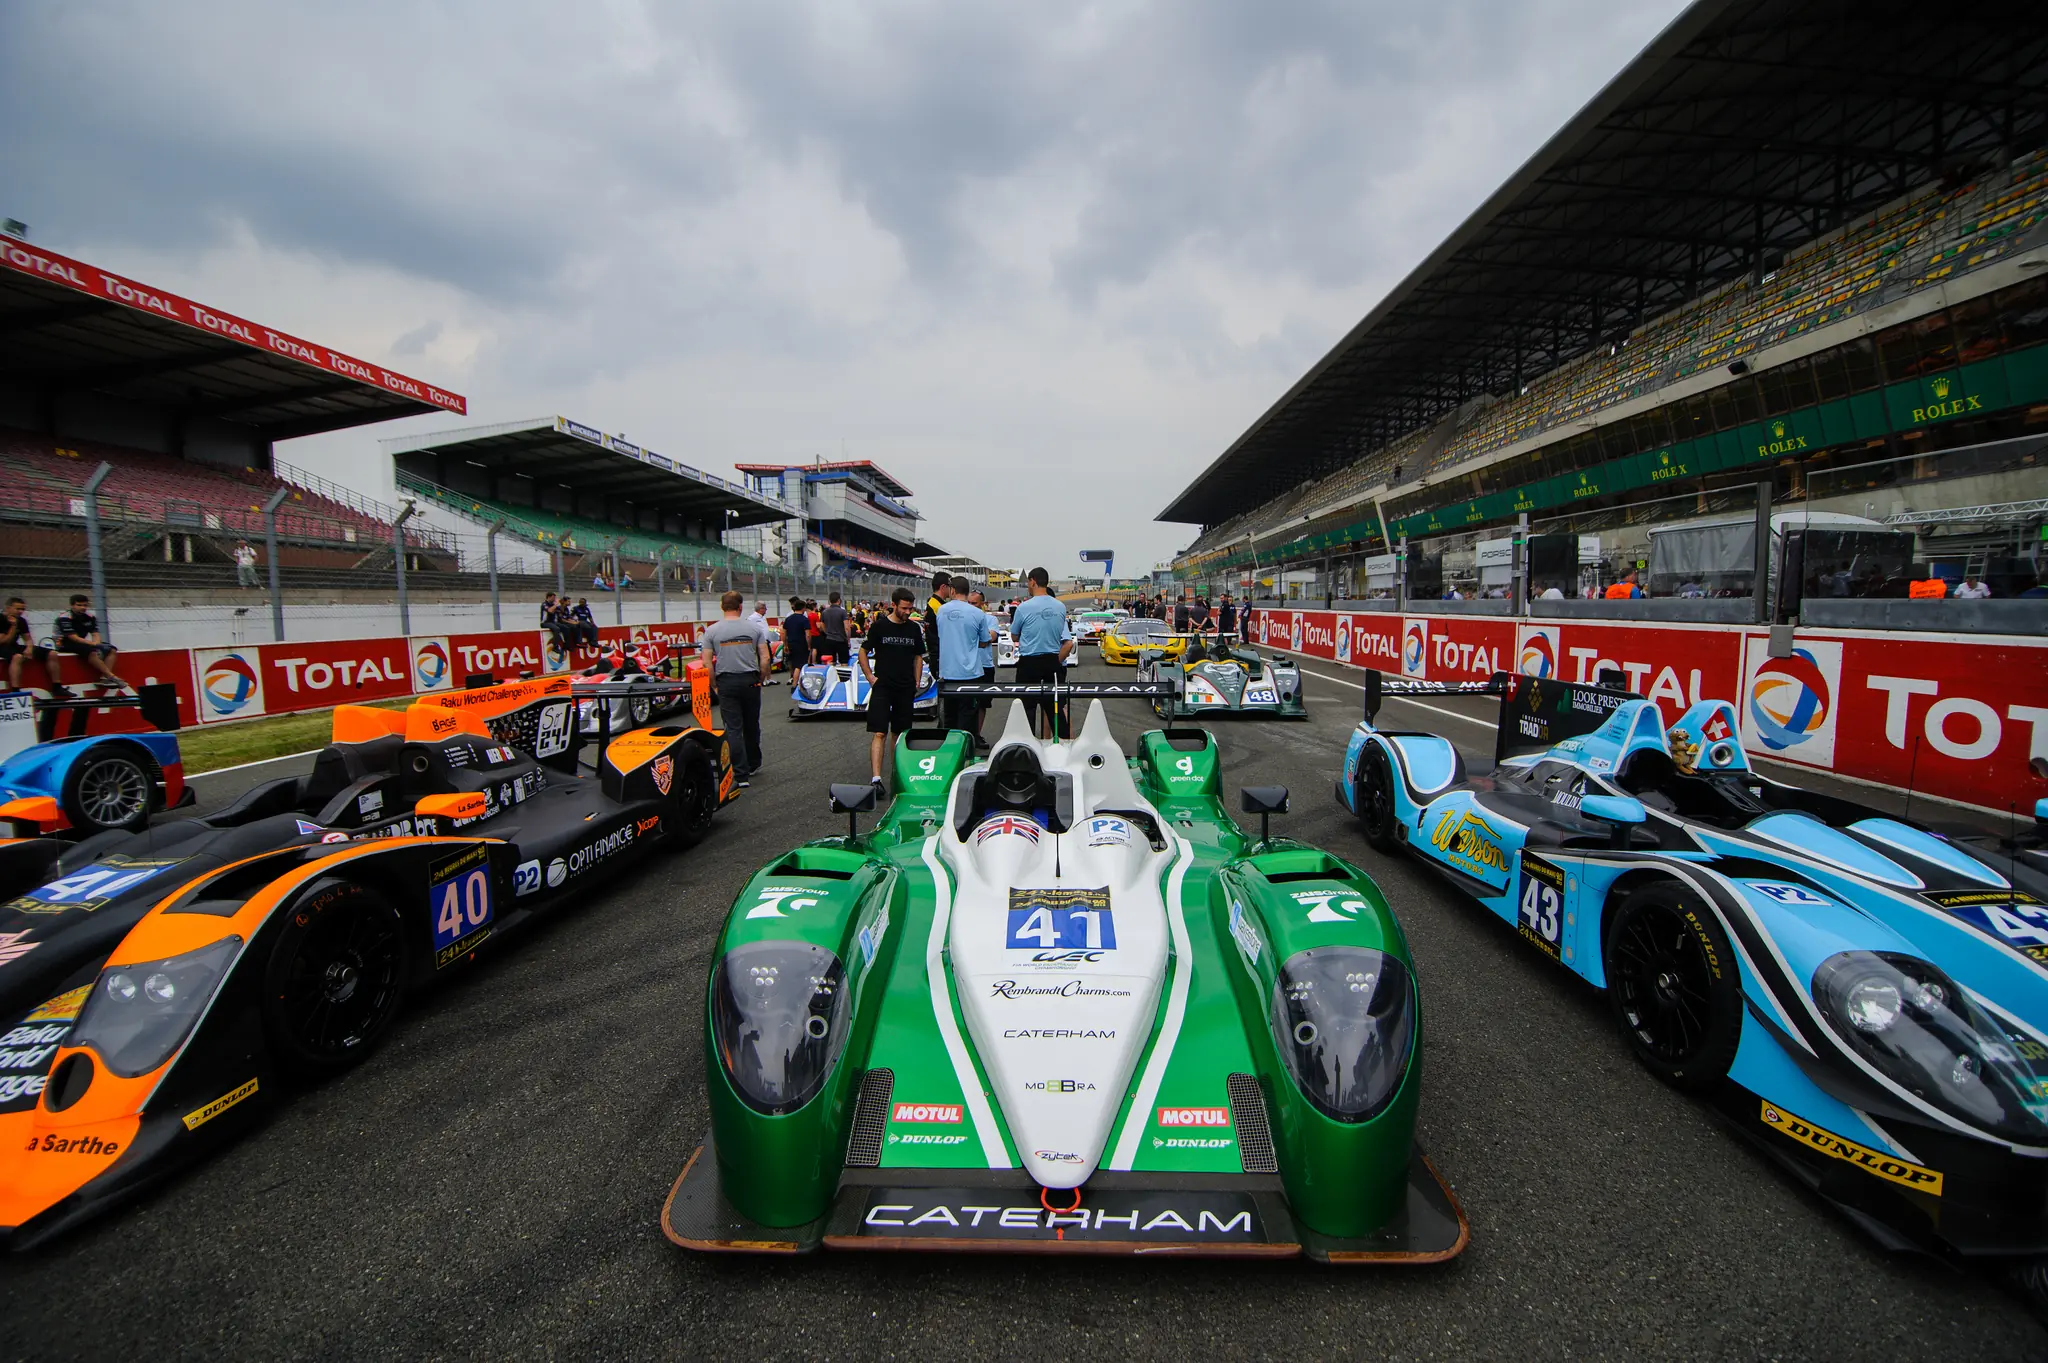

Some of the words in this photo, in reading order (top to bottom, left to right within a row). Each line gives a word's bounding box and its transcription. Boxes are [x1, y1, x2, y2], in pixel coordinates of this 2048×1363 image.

[0, 240, 87, 288] TOTAL
[99, 273, 180, 317] TOTAL
[190, 304, 256, 342] TOTAL
[264, 330, 320, 364] TOTAL
[326, 352, 375, 381] TOTAL
[380, 371, 423, 397] TOTAL
[426, 387, 464, 411] TOTAL
[1911, 394, 1983, 423] ROLEX
[1758, 436, 1808, 457] ROLEX
[1651, 464, 1688, 481] ROLEX
[1573, 484, 1600, 499] ROLEX
[1513, 500, 1535, 512] ROLEX
[1466, 512, 1484, 523] ROLEX
[1367, 561, 1392, 571] PORSCHE
[1268, 618, 1291, 640] TOTAL
[1304, 622, 1334, 647] TOTAL
[1354, 626, 1400, 659] TOTAL
[457, 645, 539, 673] TOTAL
[1432, 634, 1508, 676] TOTAL
[274, 656, 405, 693] TOTAL
[440, 694, 463, 708] Baku
[463, 692, 487, 705] World
[486, 687, 522, 702] Challenge
[1250, 690, 1274, 702] 48
[1573, 689, 1597, 705] LOOK
[1572, 701, 1604, 715] IMMOBILIER
[1519, 719, 1549, 741] TRADOR
[1521, 714, 1548, 726] INVESTOR
[909, 775, 930, 783] green
[930, 773, 943, 781] dot
[1169, 775, 1190, 783] green
[1190, 773, 1204, 782] dot
[458, 804, 466, 813] La
[467, 799, 485, 810] Sarthe
[1091, 819, 1126, 834] P2
[1431, 807, 1509, 872] Warson
[569, 846, 593, 872] OPTI
[1448, 853, 1484, 875] MOTORS
[1522, 858, 1530, 868] 24
[42, 868, 158, 901] 40
[514, 866, 539, 891] P2
[760, 886, 830, 897] ZAISGroup
[1013, 889, 1037, 897] 24
[1289, 889, 1361, 899] ZAISGroup
[1761, 885, 1820, 902] P2
[1940, 894, 1958, 905] 24
[436, 870, 488, 938] 40
[1014, 901, 1033, 909] 24
[1032, 896, 1059, 905] HEURES
[1521, 876, 1559, 942] 43
[1015, 907, 1102, 949] 41
[1519, 924, 1530, 939] 24
[439, 945, 454, 965] 24
[1684, 911, 1722, 980] DUNLOP
[1031, 950, 1105, 963] WEC
[990, 979, 1131, 1000] RembrandtCharms.com
[0, 1022, 72, 1046] Baku
[1003, 1029, 1116, 1039] CATERHAM
[0, 1044, 60, 1069] orld
[202, 1081, 257, 1120] DUNLOP
[895, 1105, 960, 1122] MOTUL
[1161, 1109, 1228, 1126] MOTUL
[24, 1136, 39, 1152] a
[41, 1133, 119, 1156] Sarthe
[900, 1134, 966, 1145] DUNLOP
[1165, 1138, 1231, 1149] DUNLOP
[1040, 1149, 1079, 1162] zytek
[1786, 1120, 1939, 1185] DUNLOP
[864, 1204, 1252, 1232] CATERHAM
